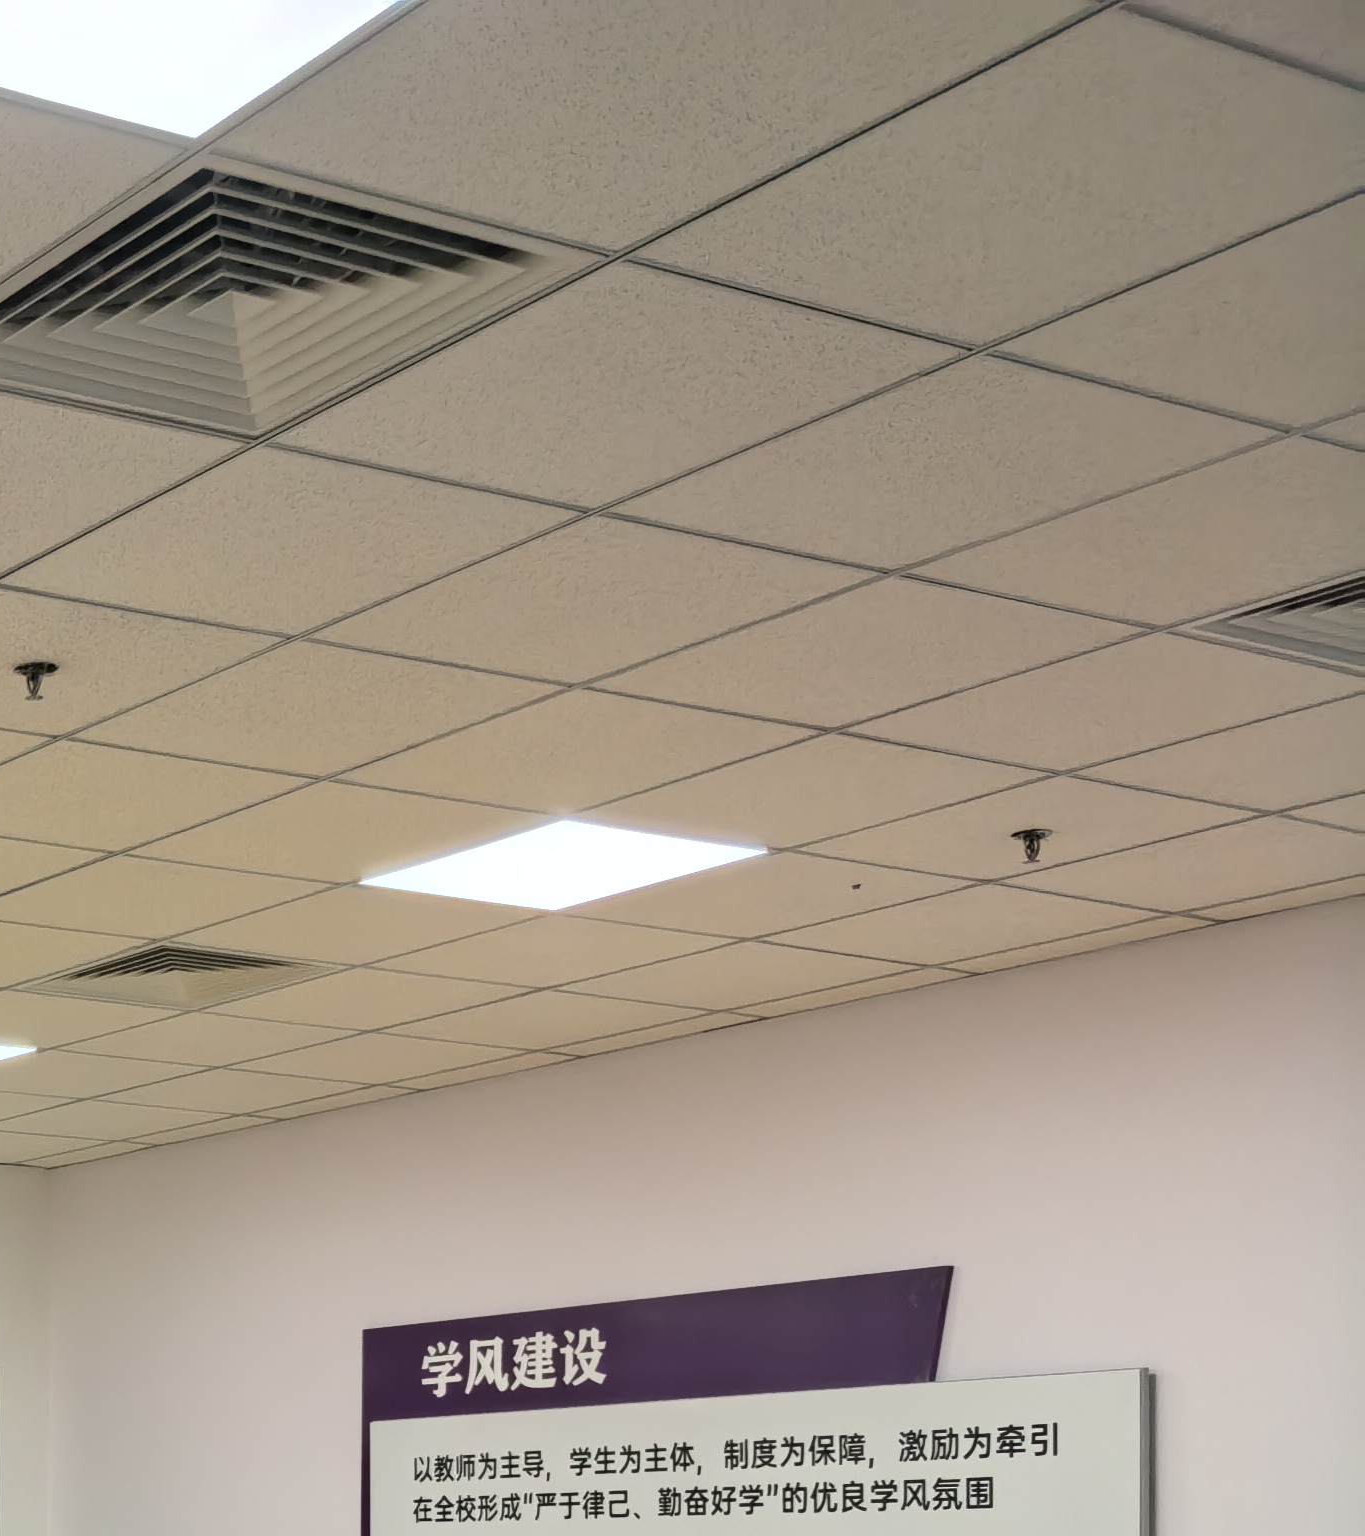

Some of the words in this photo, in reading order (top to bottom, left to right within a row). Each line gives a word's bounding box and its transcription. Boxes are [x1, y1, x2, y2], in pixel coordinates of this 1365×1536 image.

[421, 1328, 607, 1397] 学风建设
[413, 1422, 1059, 1483] 以教师为主导，学生为主体，制度为保障，激励为牵引
